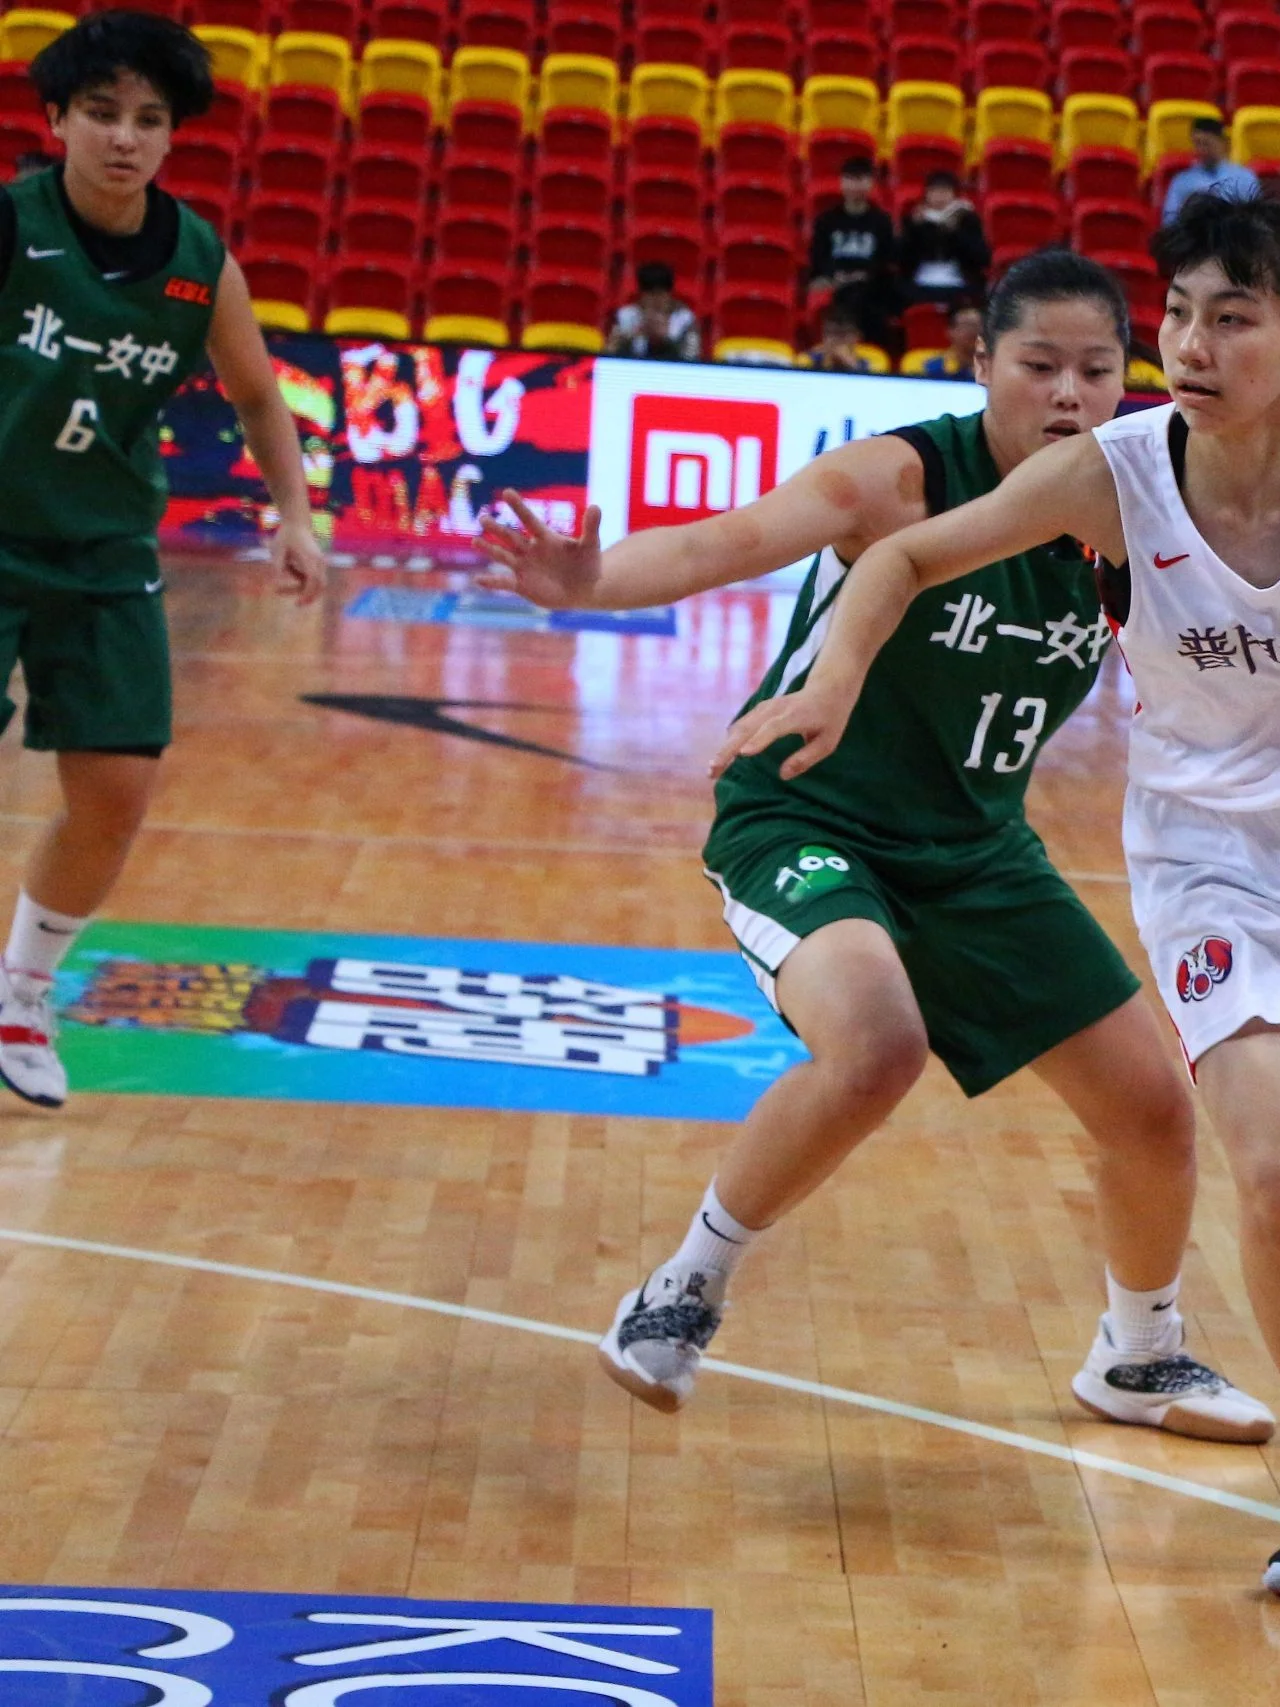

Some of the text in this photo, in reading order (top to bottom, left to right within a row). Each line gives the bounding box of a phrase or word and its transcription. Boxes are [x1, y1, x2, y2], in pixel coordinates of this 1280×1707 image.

[17, 302, 179, 384] 北一女中
[55, 399, 98, 453] 6
[962, 692, 1047, 773] 13
